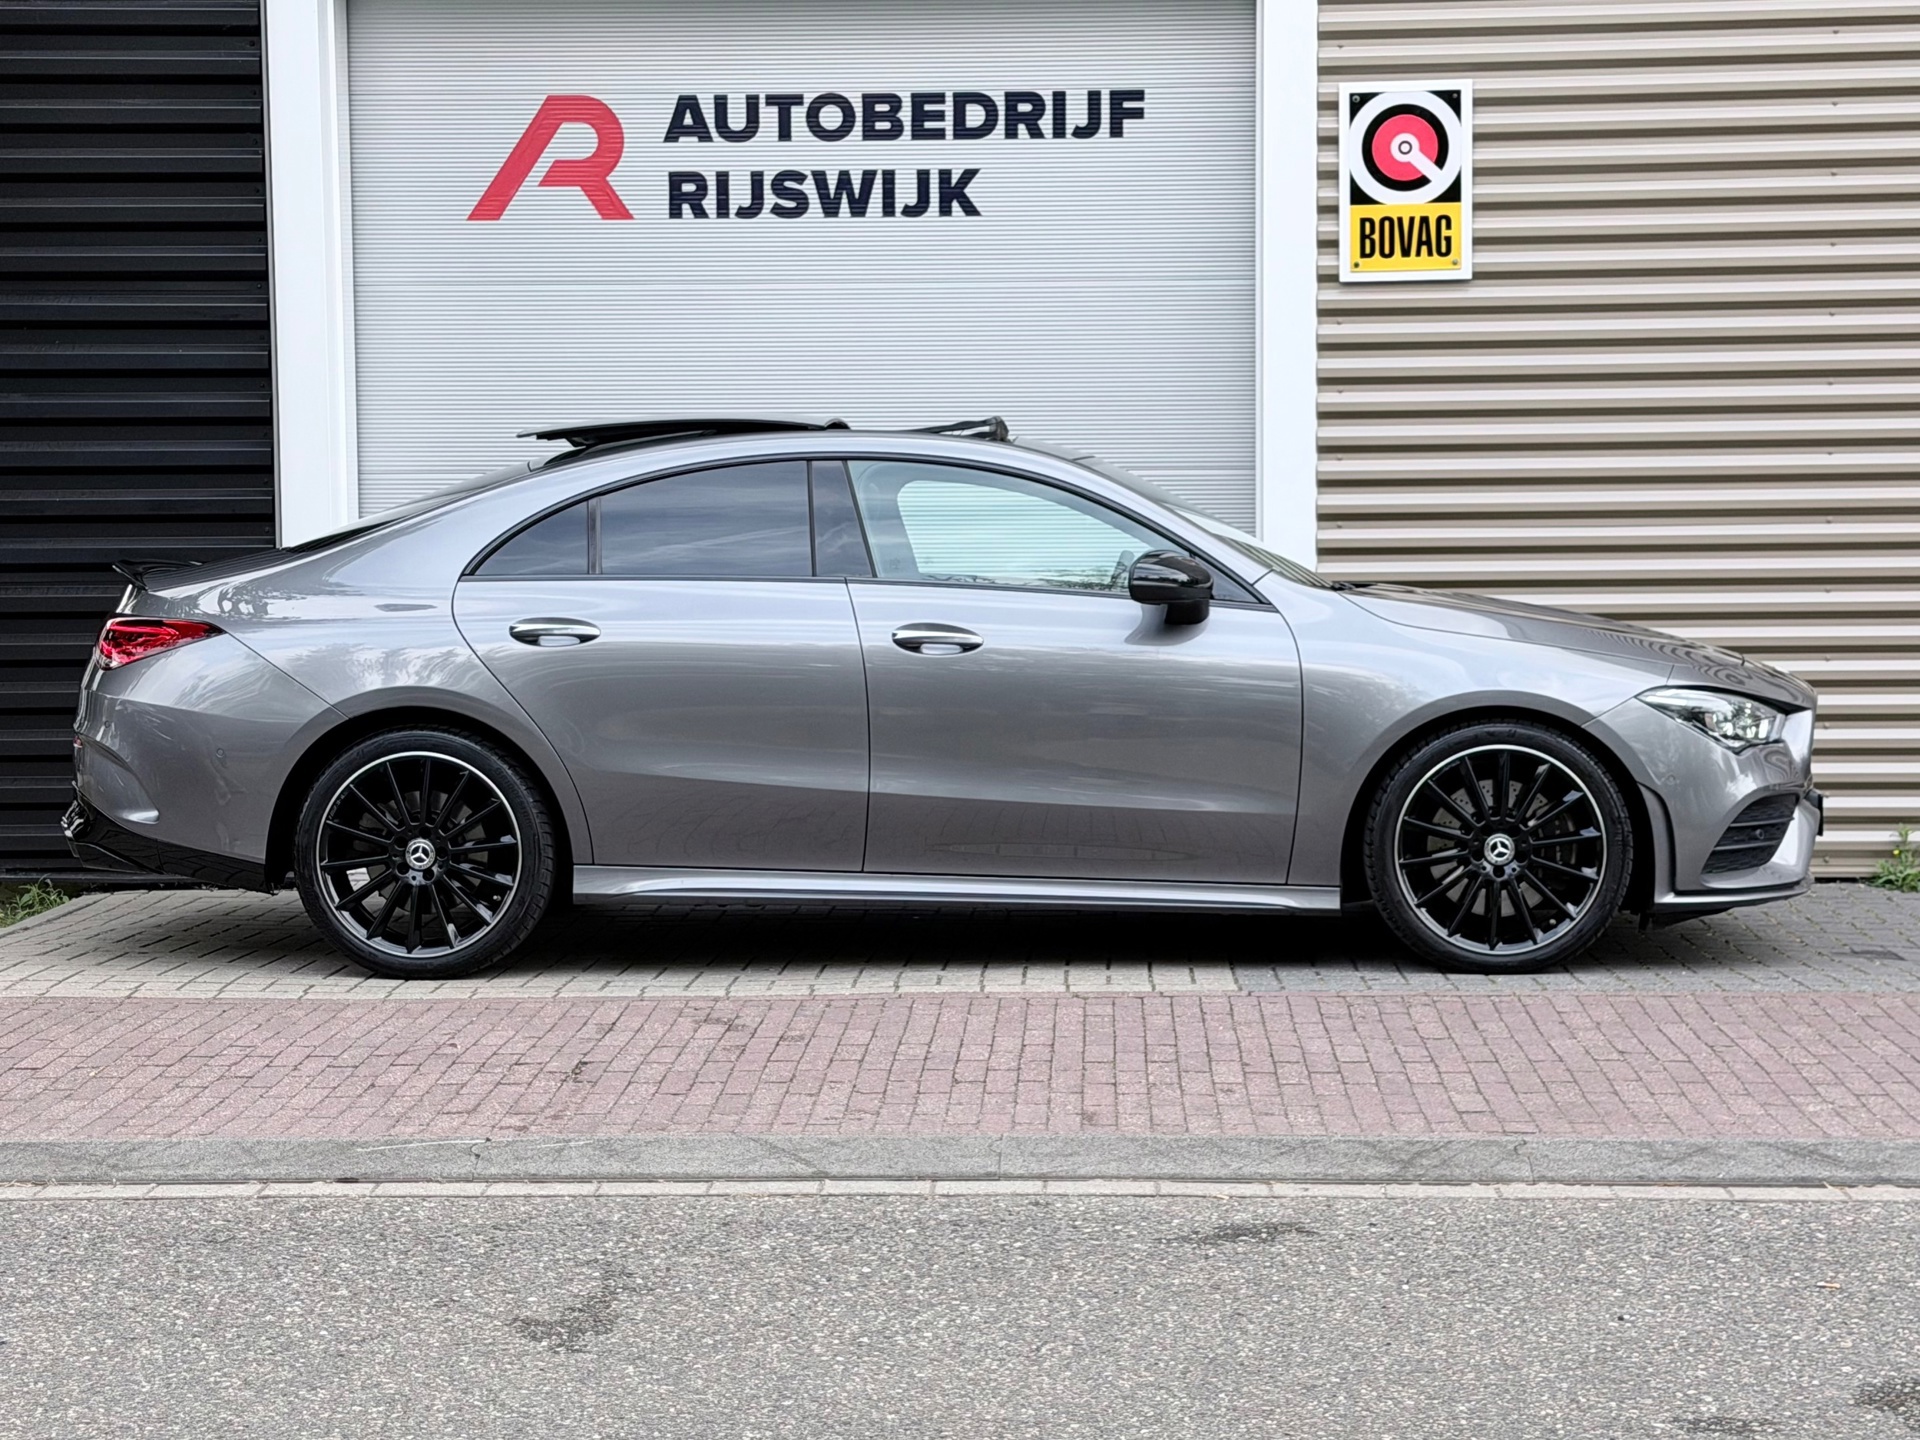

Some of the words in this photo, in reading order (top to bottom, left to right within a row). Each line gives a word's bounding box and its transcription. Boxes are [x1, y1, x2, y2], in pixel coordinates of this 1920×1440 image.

[664, 89, 1146, 142] AUTOBEDRIJF
[668, 168, 982, 219] RIJSWIJK
[1359, 214, 1452, 259] BOVAG
